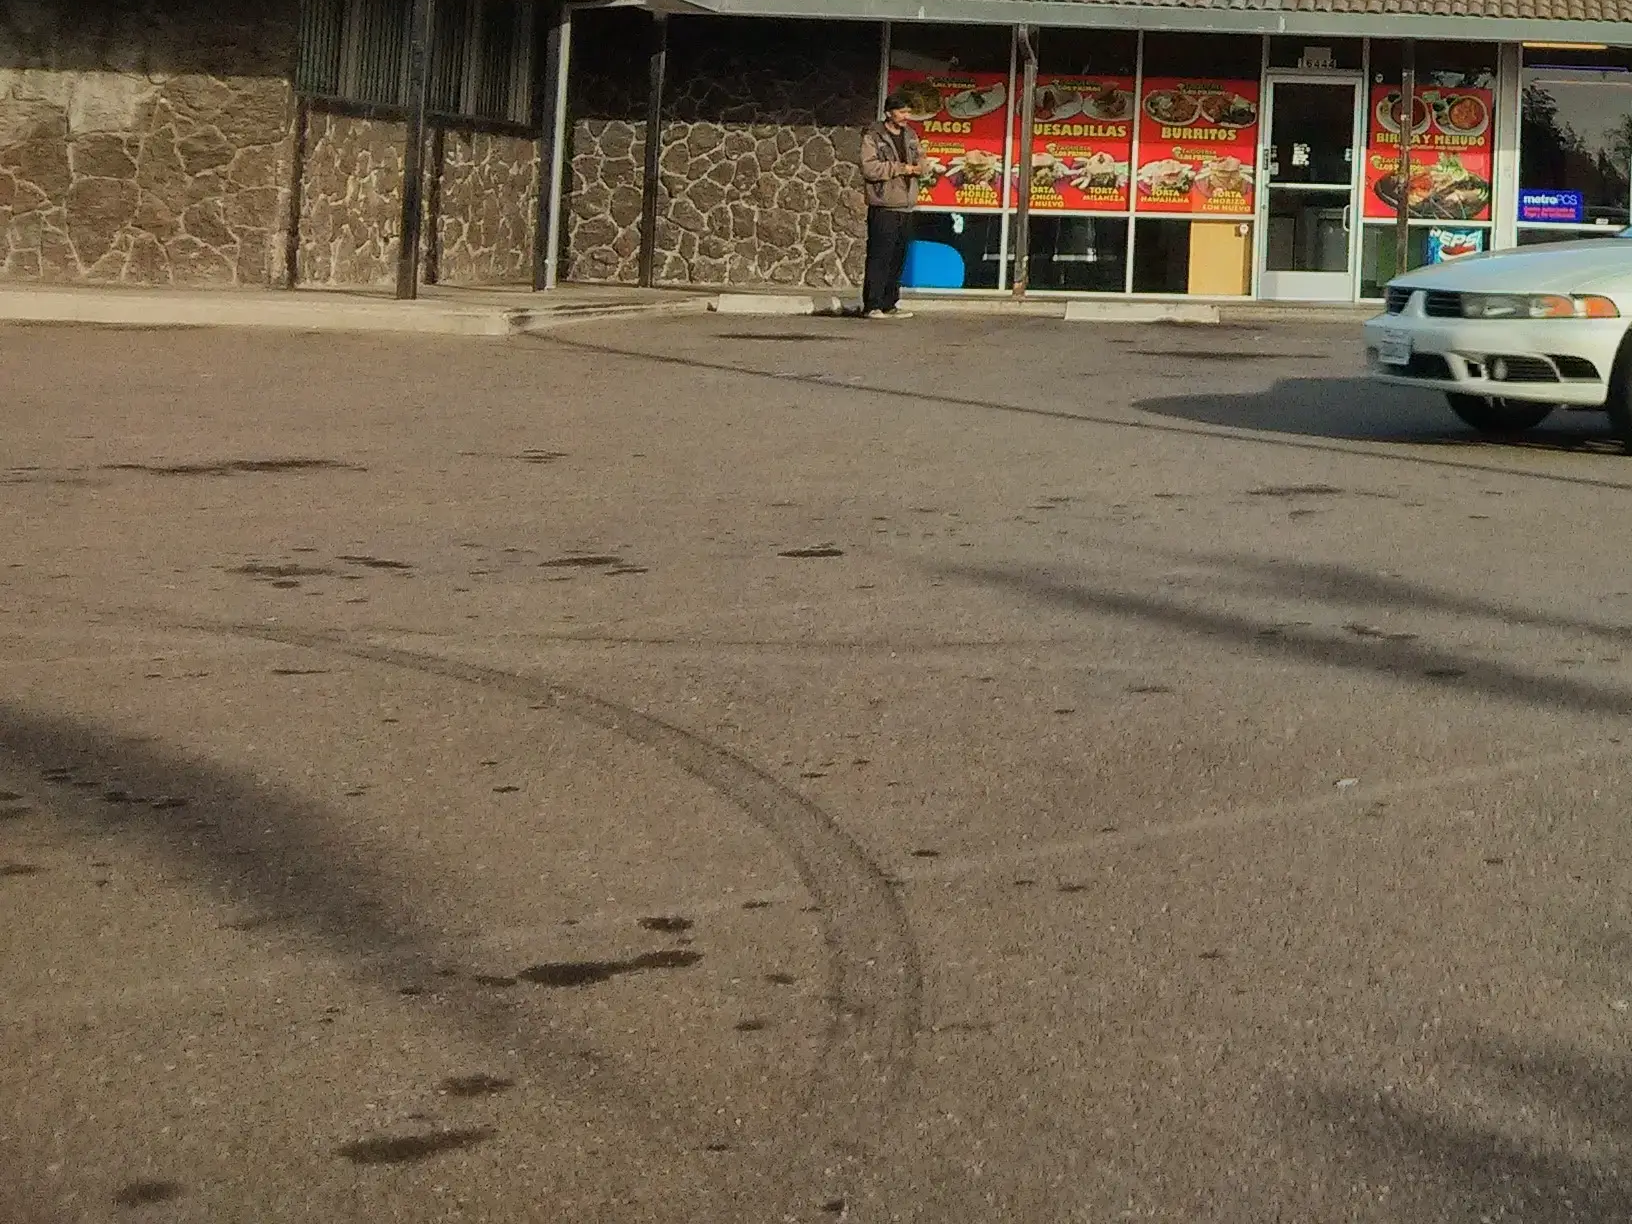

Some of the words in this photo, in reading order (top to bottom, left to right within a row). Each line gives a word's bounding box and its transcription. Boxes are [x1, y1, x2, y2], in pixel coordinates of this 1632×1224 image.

[923, 121, 972, 133] TACOS
[1033, 124, 1127, 137] UESADILLAS
[1161, 127, 1237, 141] BURRITOS
[1434, 134, 1485, 146] MENUDO
[1213, 190, 1242, 198] TORTA
[1524, 194, 1577, 205] metroPCS
[1221, 205, 1251, 213] HUEVO
